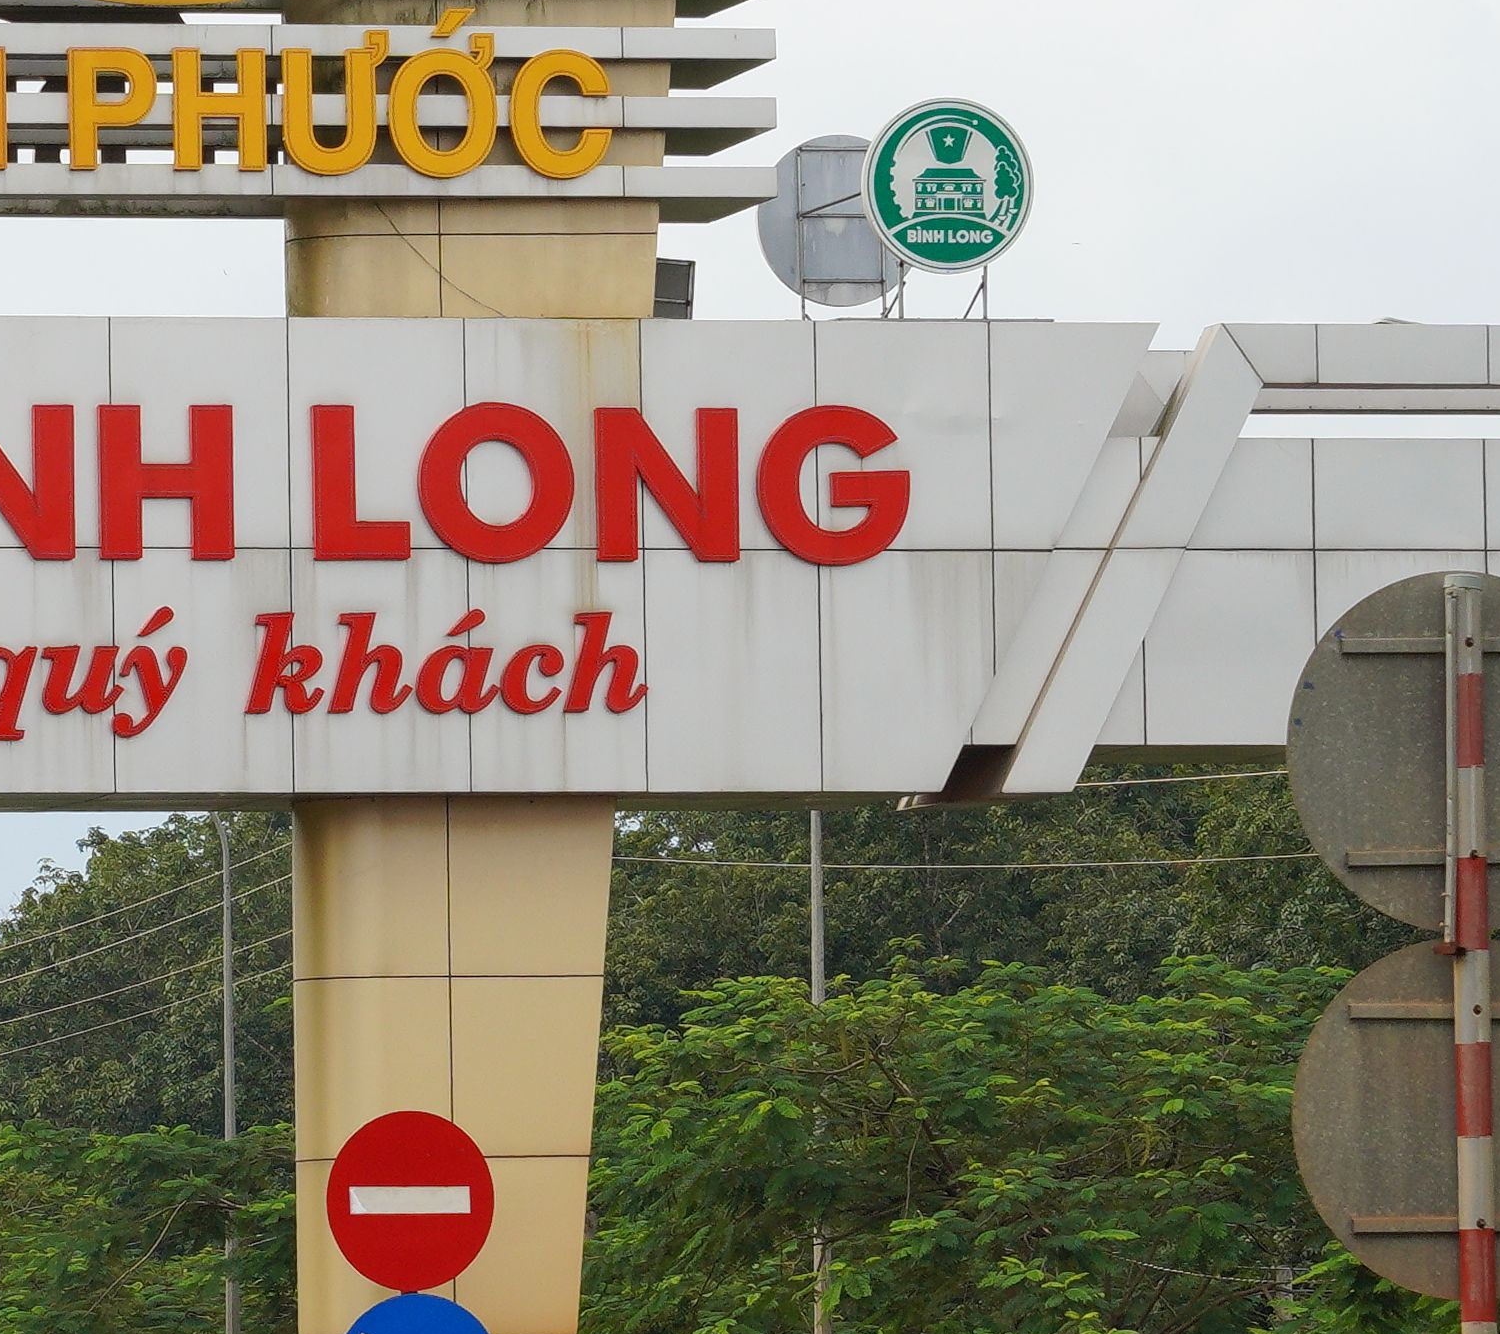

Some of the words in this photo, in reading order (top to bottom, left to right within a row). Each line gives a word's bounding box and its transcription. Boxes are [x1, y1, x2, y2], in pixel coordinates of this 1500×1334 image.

[67, 9, 613, 179] PHƯỚC
[907, 225, 945, 244] BÌNH
[947, 229, 994, 245] LONG
[311, 401, 912, 566] LONG
[246, 609, 649, 715] khách
